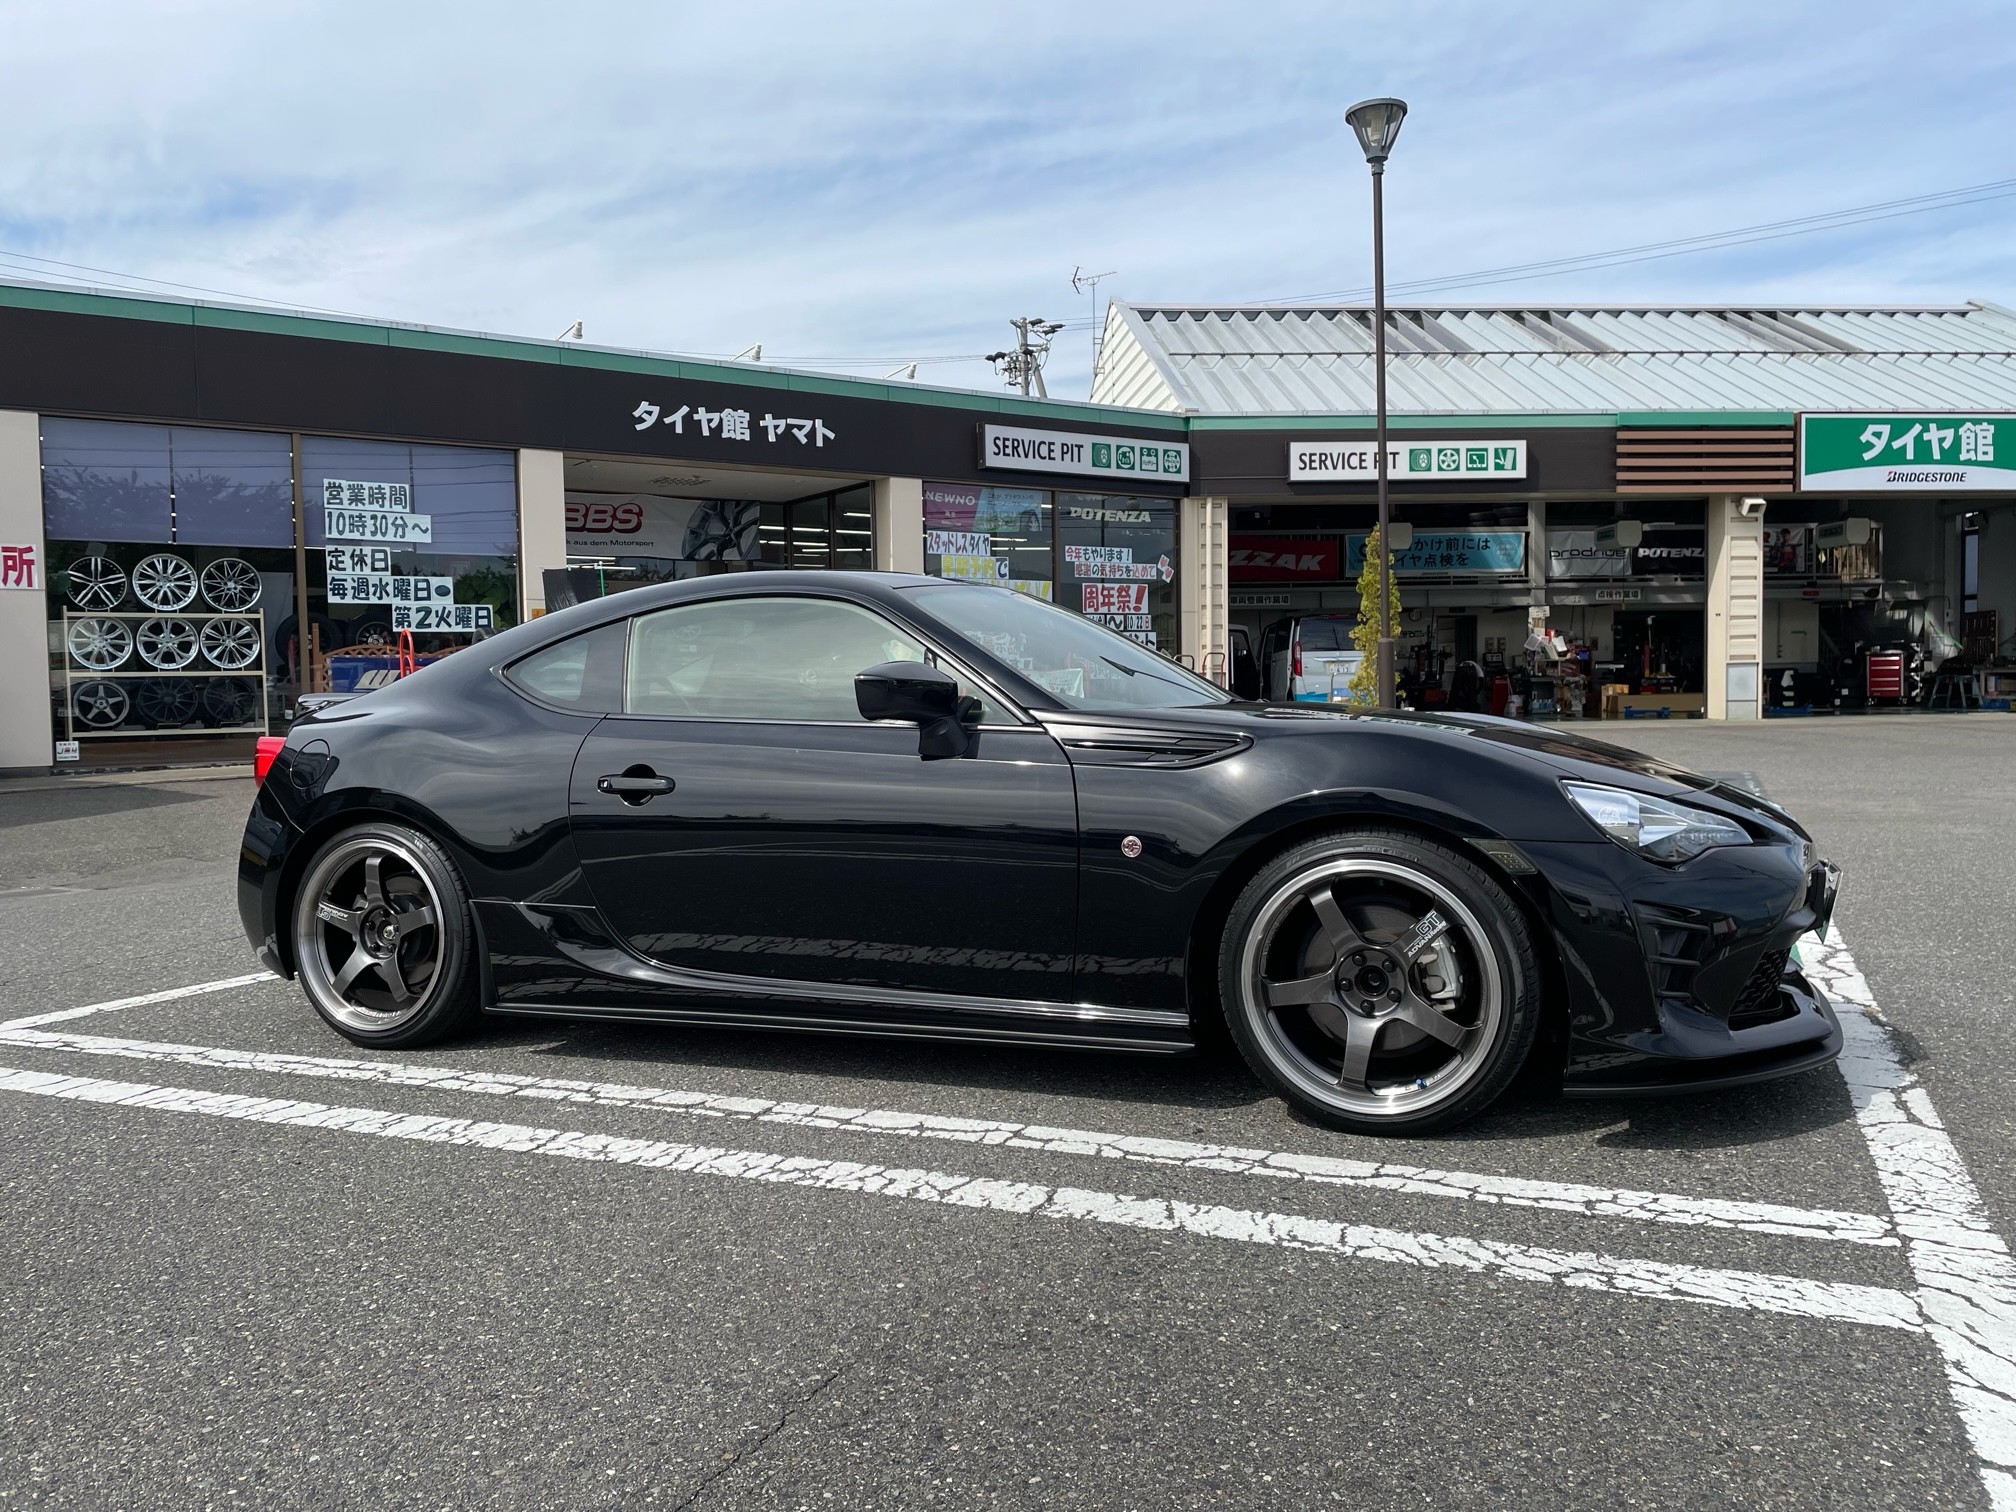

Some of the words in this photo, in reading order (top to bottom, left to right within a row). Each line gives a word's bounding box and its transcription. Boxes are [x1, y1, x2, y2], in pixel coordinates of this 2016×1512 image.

[632, 401, 750, 441] タイヤ館
[760, 413, 836, 447] ヤマト
[993, 436, 1056, 461] SERVICE
[1061, 442, 1084, 463] PIT
[1859, 421, 1995, 461] タイヤ館
[1298, 452, 1368, 471] SERVICE
[1374, 451, 1400, 470] PT
[1886, 471, 1967, 483] BRIDGESTONE
[325, 481, 408, 510] 営業時間
[926, 490, 976, 506] NEWNO
[565, 502, 644, 534] BBS
[1070, 507, 1151, 522] POTENZA
[928, 531, 990, 555] スタッドレスタイヤ
[1, 546, 35, 588] 所
[328, 548, 390, 572] 定休日
[1075, 563, 1156, 577] 感謝の気持ちを込めて
[394, 606, 493, 629] 第2火曜日
[1416, 910, 1440, 937] GT
[1408, 935, 1432, 958] ADVAN
